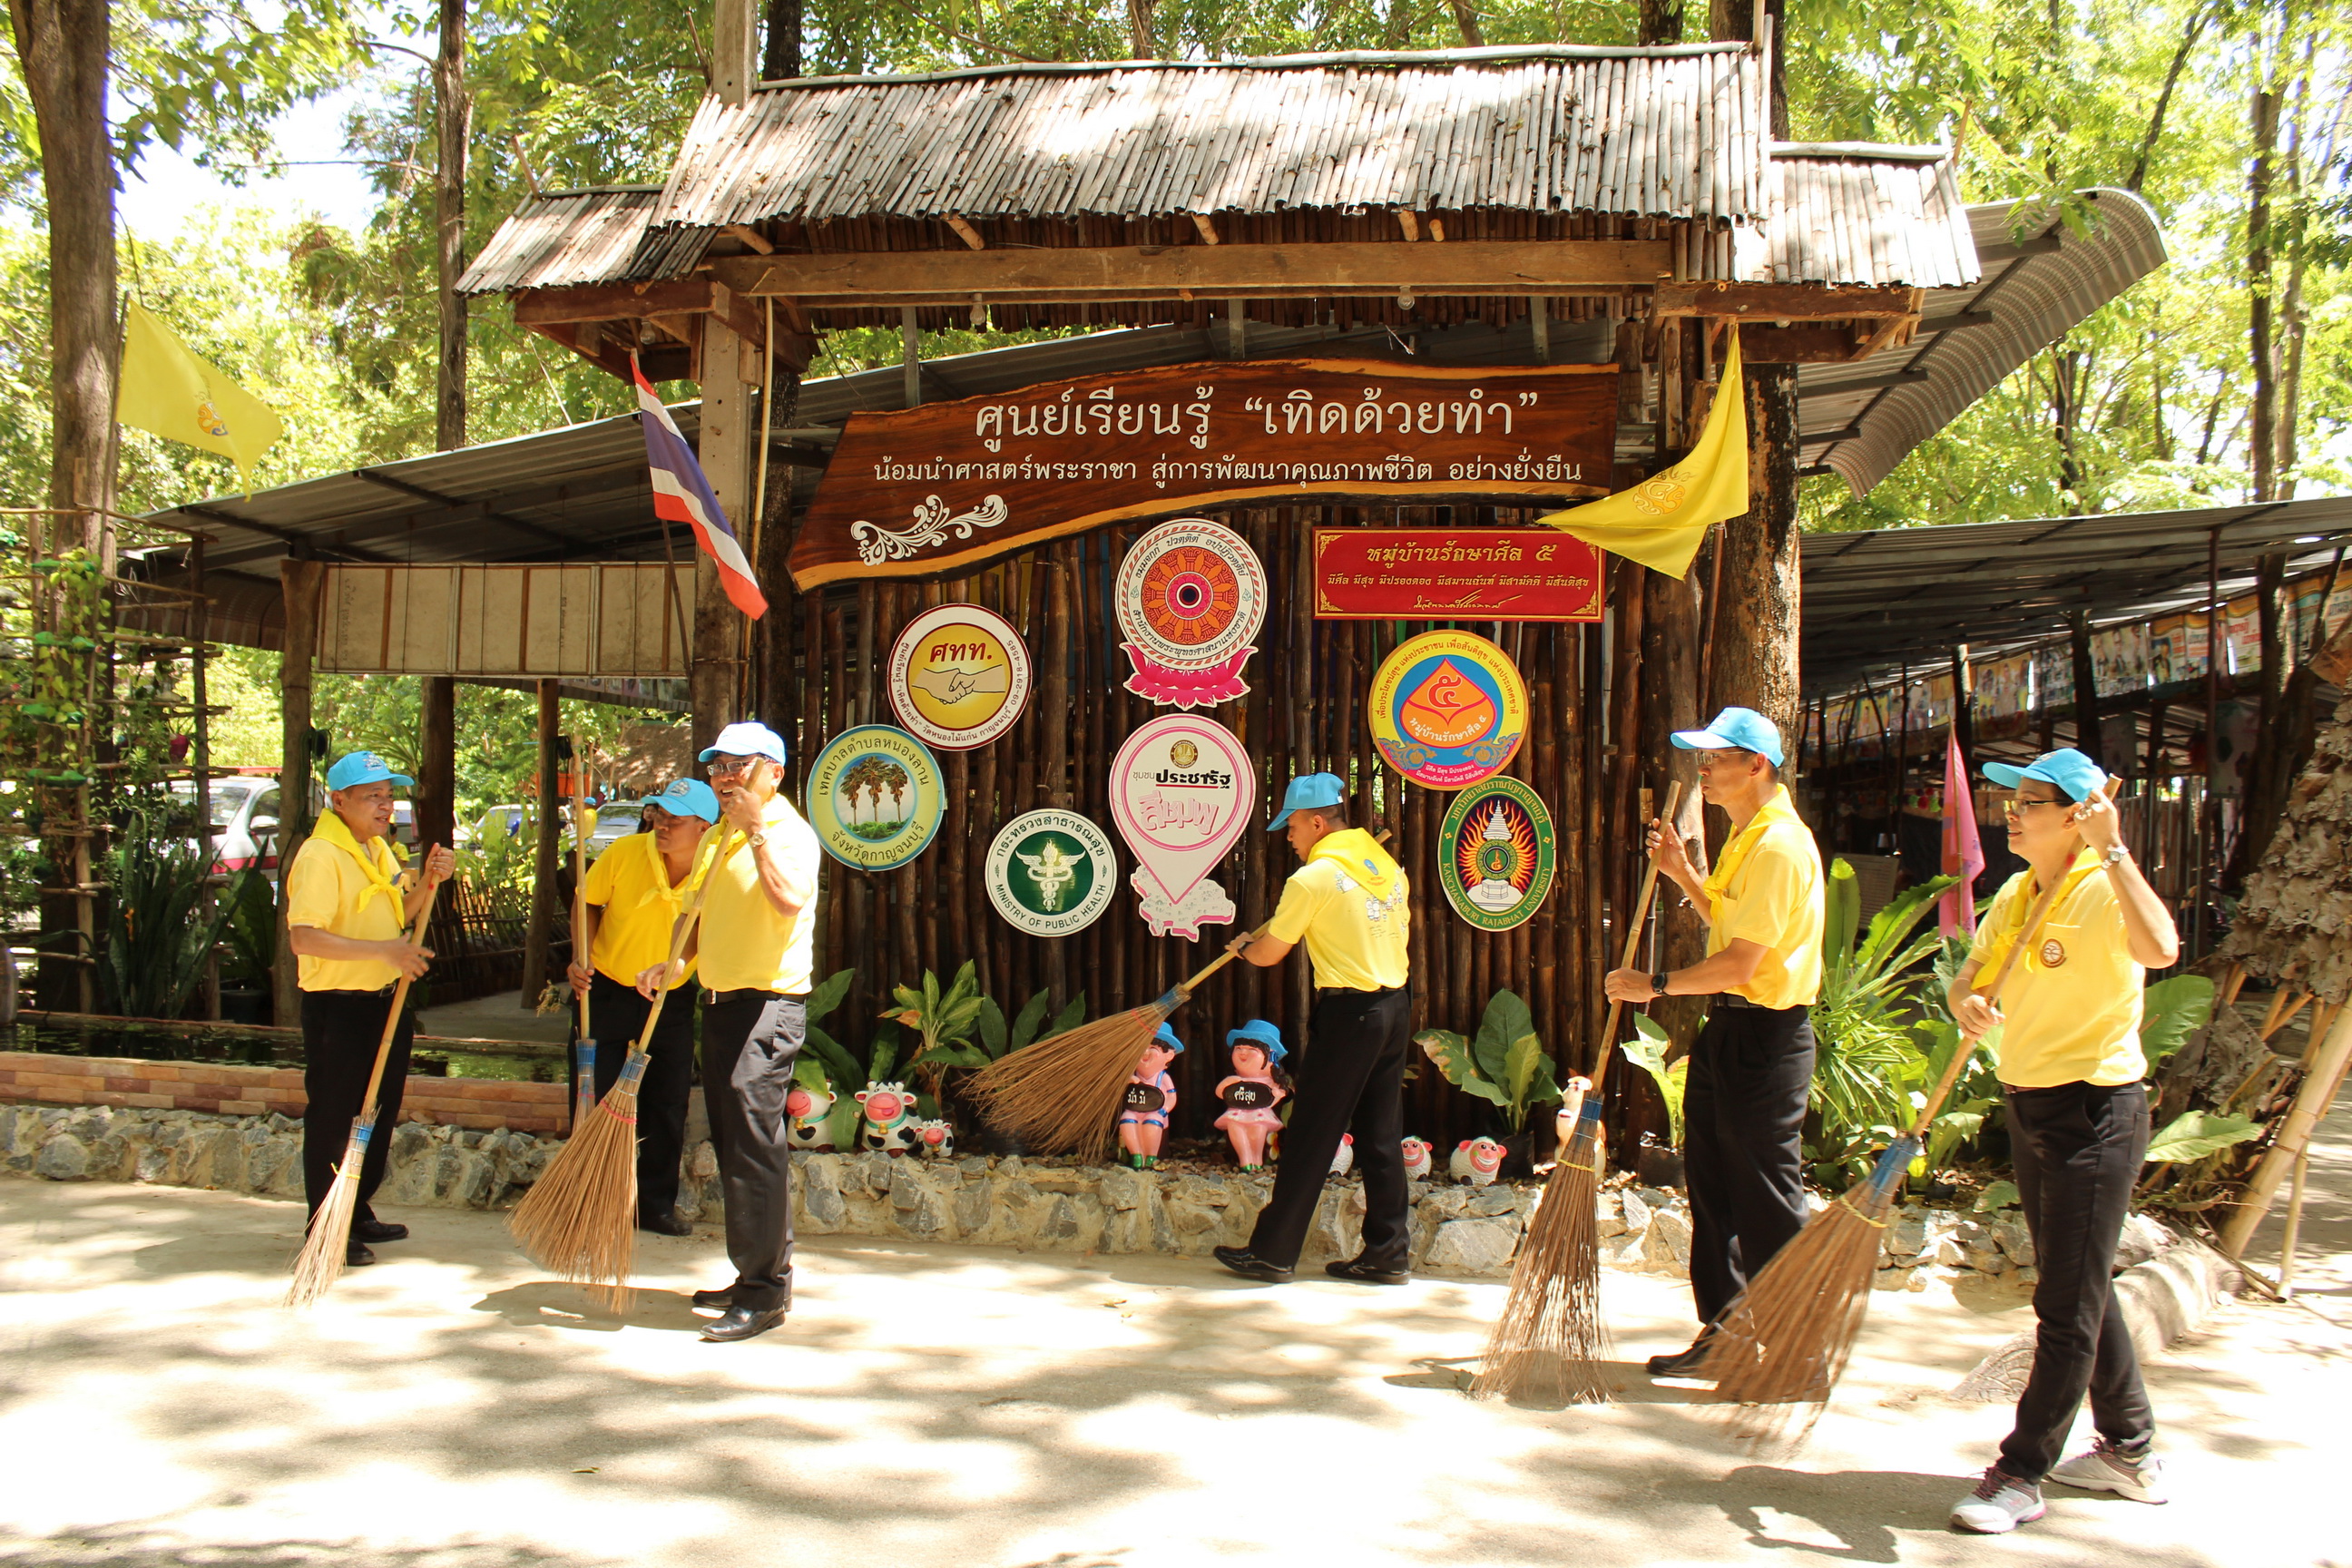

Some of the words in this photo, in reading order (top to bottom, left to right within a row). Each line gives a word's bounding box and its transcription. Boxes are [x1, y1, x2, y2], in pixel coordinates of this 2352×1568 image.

[975, 385, 1214, 451] ศูนย์เรียนรู้
[1244, 387, 1539, 436] “เทิดด้วยทำ”
[873, 456, 1138, 483] น้อมนำศาสตร์พระราชา
[1152, 456, 1432, 490] สู่การพัฒนาคุณภาพชีวิต
[1449, 446, 1582, 481] อย่างยั่งยืน
[1367, 540, 1522, 569] หมู่บ้านรักษาศีล
[1534, 544, 1557, 562] ๕
[1328, 574, 1349, 585] มีศีล
[1353, 574, 1374, 588] มีสุข
[1378, 574, 1431, 585] มีปรองดอง
[1436, 573, 1494, 586] มีสมานฉันท์
[1498, 574, 1541, 587] มีสามัคคี
[1545, 575, 1589, 590] มีสันติสุข
[929, 642, 993, 662] ศทท.
[1133, 609, 1246, 657] สำนักงานพระพุทธศาสนาแห่งชาติ
[922, 724, 977, 741] วัดหนองไม้แก่น
[980, 705, 1012, 736] กาญจนบุรี
[1005, 640, 1024, 706] 09-2918-4585
[1375, 665, 1401, 720] เพื่อประโยชน์สุข
[1399, 642, 1444, 666] แห่งประชาชน
[1446, 637, 1489, 661] เพื่อสันติสุข
[1488, 658, 1519, 715] แห่งประเทศชาติ
[1427, 674, 1463, 709] ๕
[1409, 717, 1481, 742] หมู่บ้านรักษาศีล
[819, 737, 929, 796] เทศบาลตำบลหนองลาน
[1132, 771, 1155, 781] ชุมชน
[1155, 769, 1231, 789] ประชารัฐ
[1451, 780, 1549, 824] มหาวิทยาลยราชภัฏกาญจนบุรี
[832, 820, 925, 862] จังหวัดกาญจนบุรี
[996, 816, 1105, 857] กระทรวงสาธารณสุข
[995, 884, 1026, 921] MINISTRY
[1028, 917, 1042, 927] OF
[1045, 914, 1080, 929] PUBLIC
[1081, 884, 1106, 917] HEALTH
[1443, 863, 1479, 921] KANCHANABURI
[1482, 910, 1524, 927] RAJABHAT
[1524, 867, 1551, 911] UNIVERSITY
[1234, 1086, 1256, 1105] ศรีสุข
